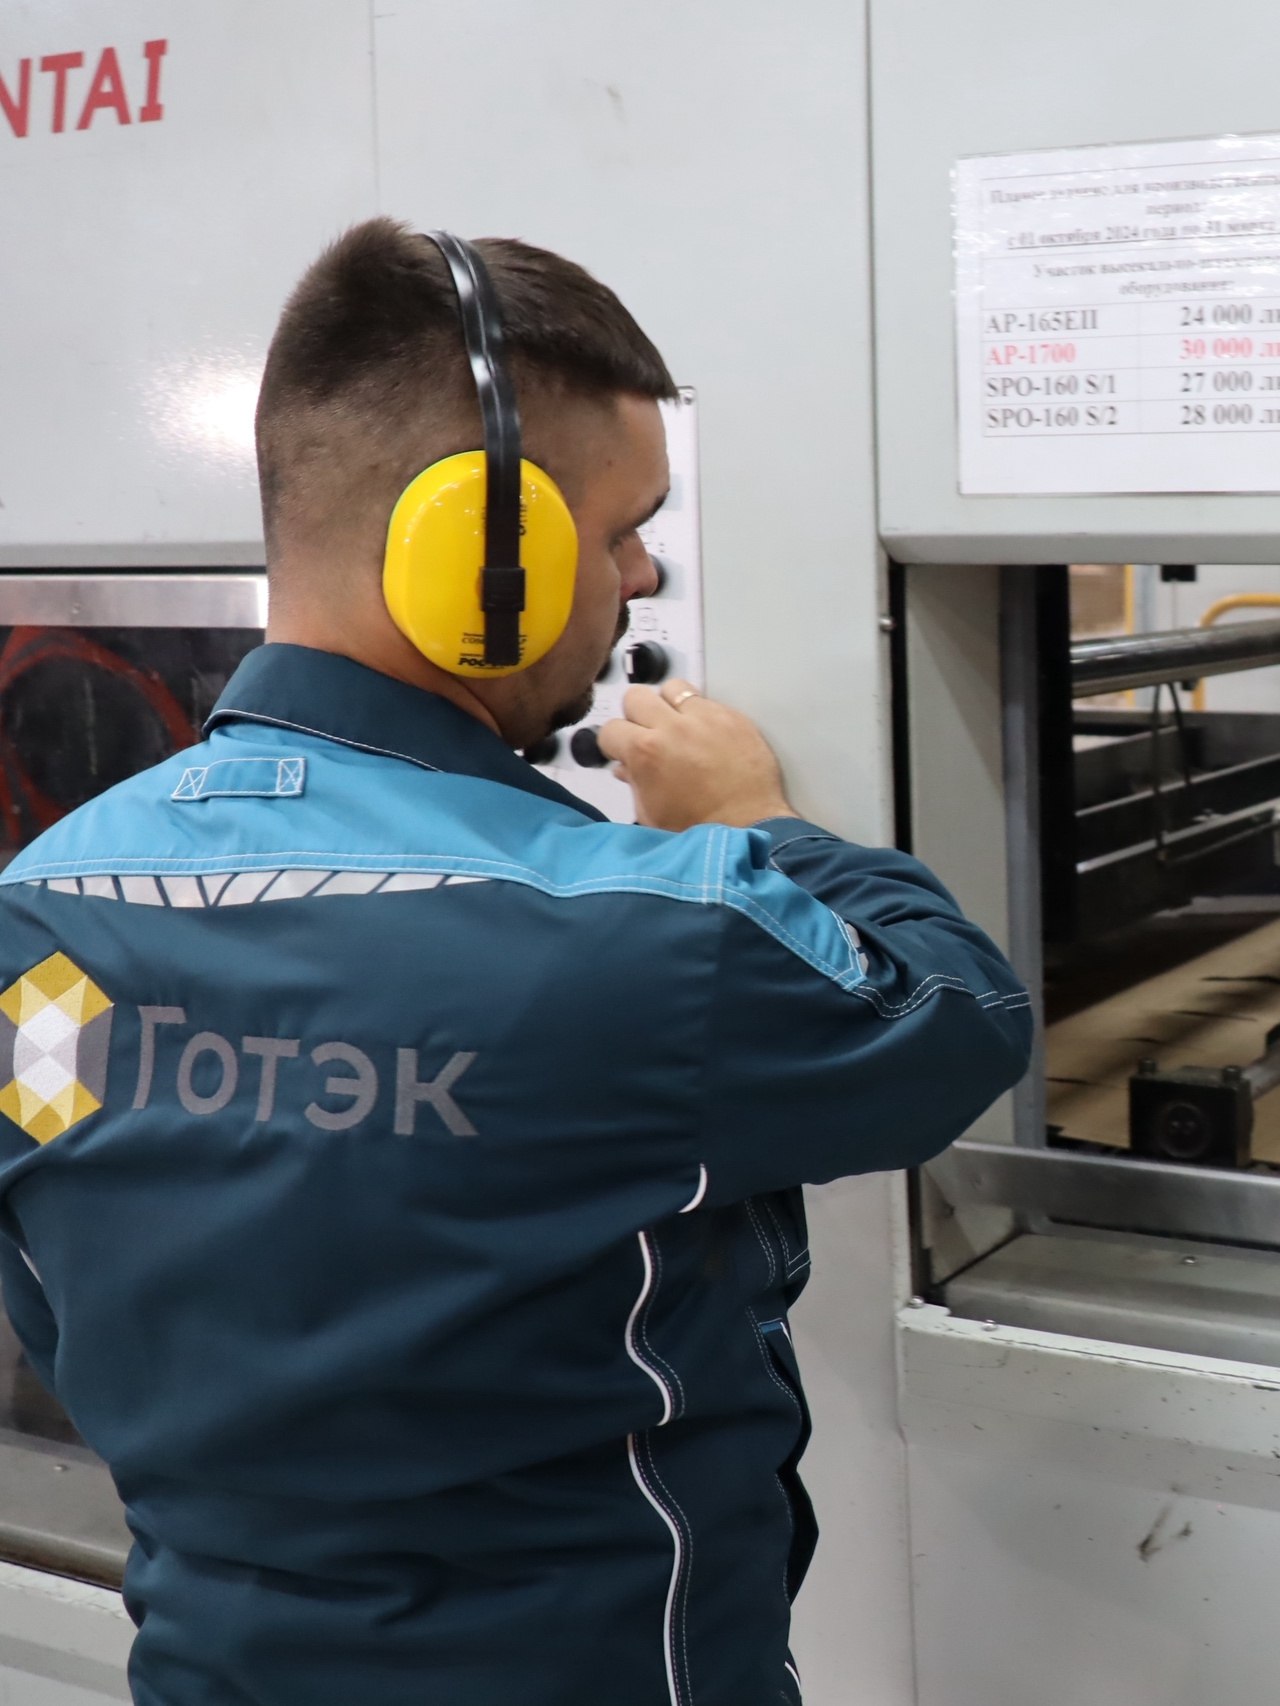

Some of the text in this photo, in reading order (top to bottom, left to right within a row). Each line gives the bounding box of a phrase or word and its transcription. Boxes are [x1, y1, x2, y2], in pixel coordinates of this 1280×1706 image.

[0, 39, 167, 138] NTAI
[1039, 227, 1101, 244] октября
[1105, 225, 1139, 240] 2024
[1143, 226, 1176, 238] года
[1180, 306, 1206, 326] 24
[1212, 304, 1252, 325] 000
[986, 343, 1076, 365] AP-1700
[1180, 339, 1206, 360] 30
[1212, 338, 1252, 358] 000
[986, 374, 1117, 398] SPO-160 S/1
[1180, 372, 1206, 393] 27
[1212, 371, 1252, 392] 000
[986, 405, 1118, 430] SPO-160 S/2
[1180, 404, 1206, 425] 28
[1212, 404, 1252, 425] 000
